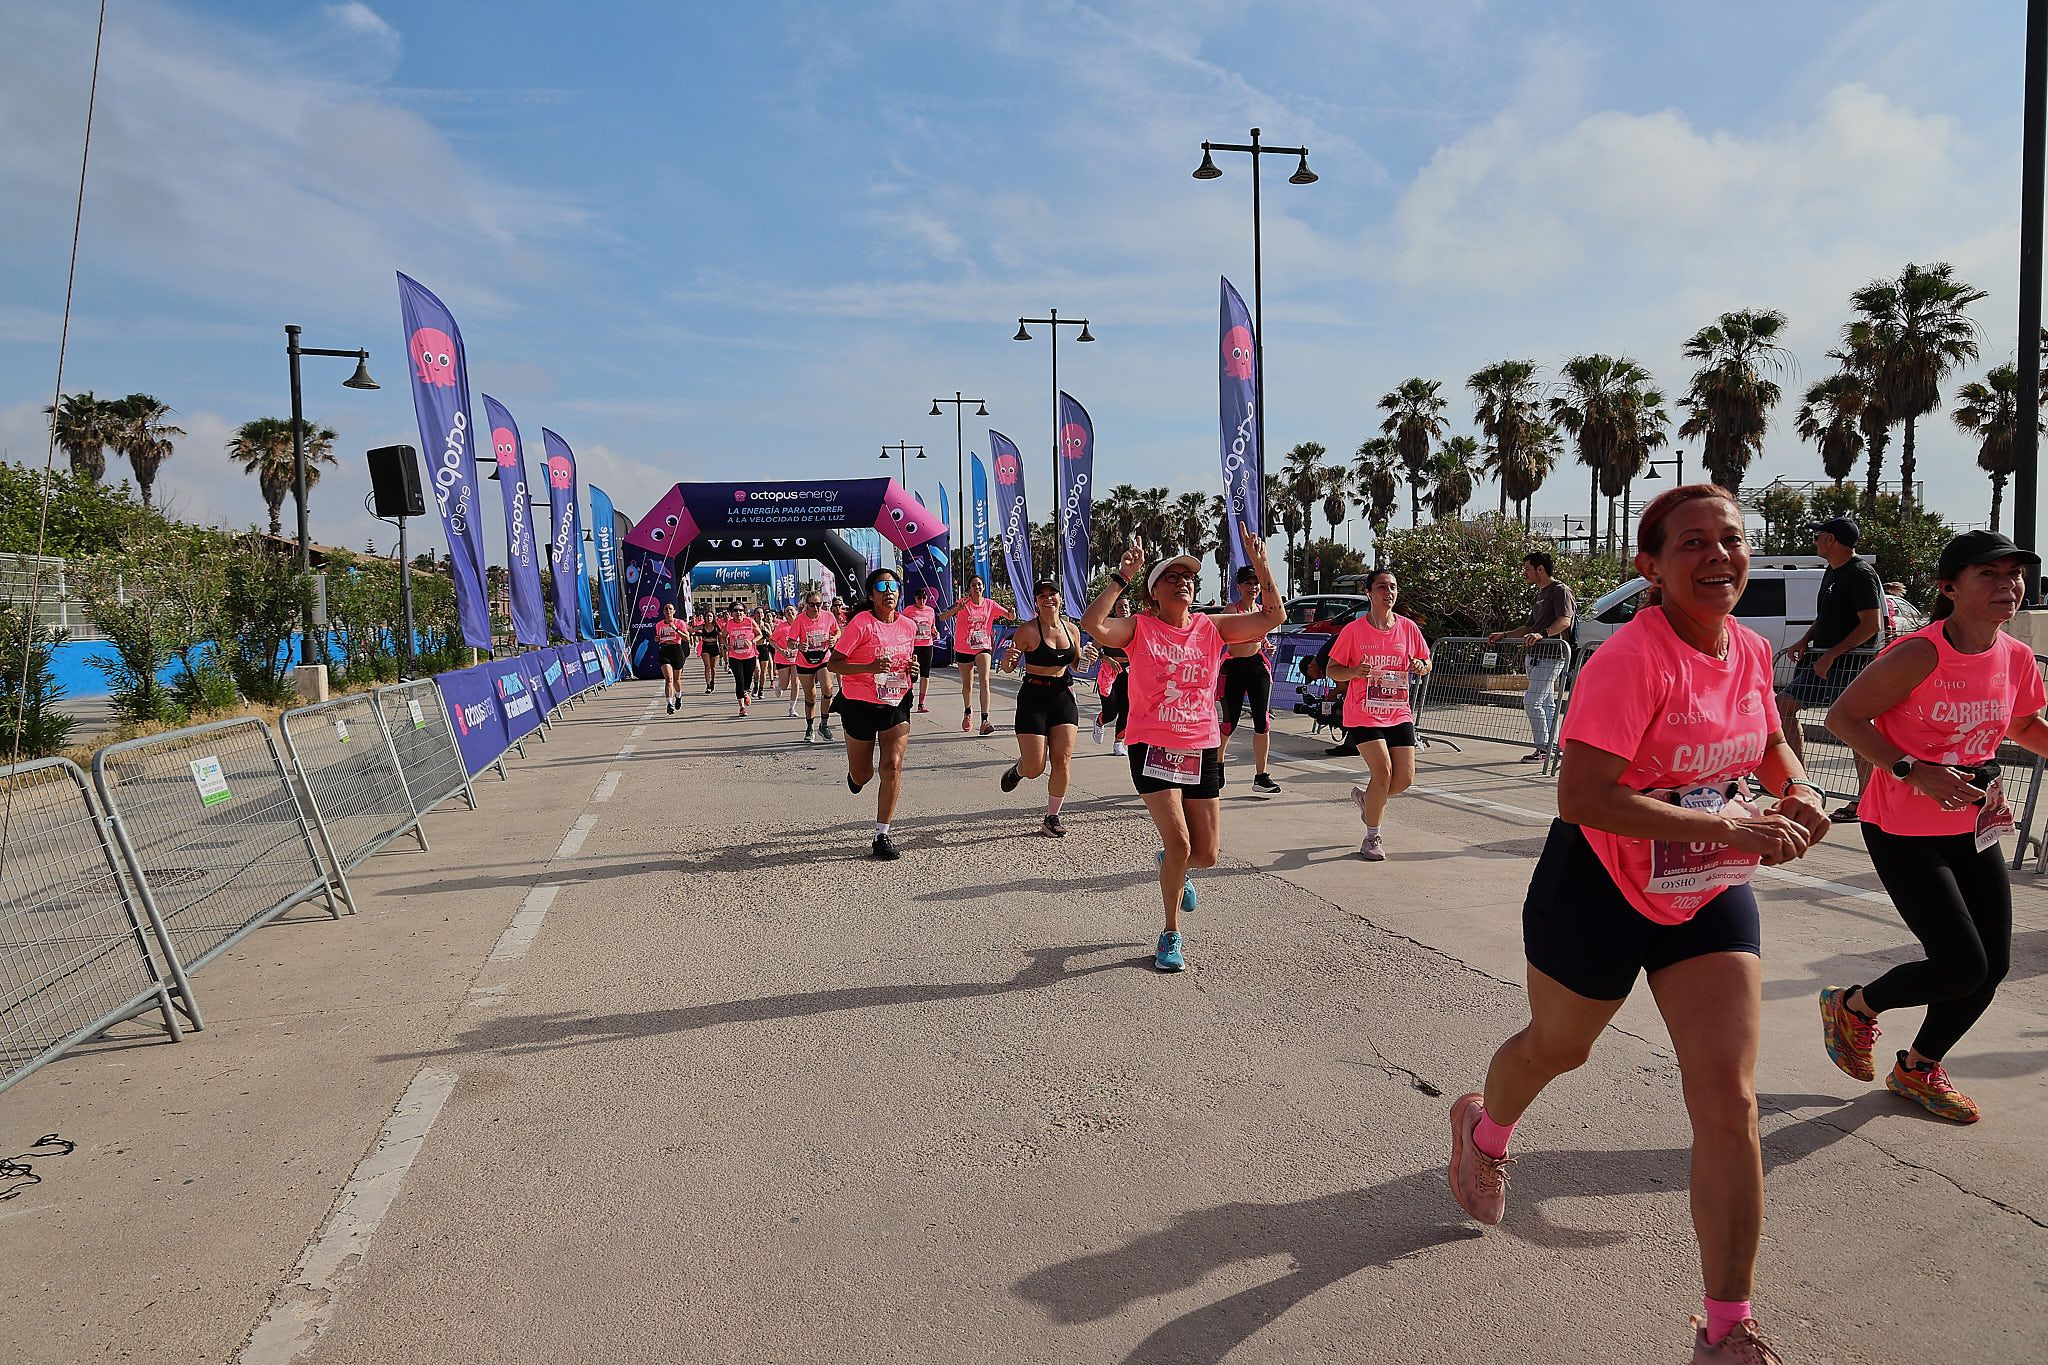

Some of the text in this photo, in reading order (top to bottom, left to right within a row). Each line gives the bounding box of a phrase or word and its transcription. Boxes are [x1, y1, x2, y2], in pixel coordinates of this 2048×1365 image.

[750, 490, 839, 502] octopus energy
[728, 505, 843, 515] LA ENERGÍA PARA CORRER
[749, 515, 800, 523] VELOCIDAD
[707, 537, 807, 548] VOLVO
[1667, 709, 1716, 725] OYSHO
[1165, 753, 1185, 764] 016
[1711, 872, 1748, 880] Santander
[1661, 877, 1697, 890] OYSHO
